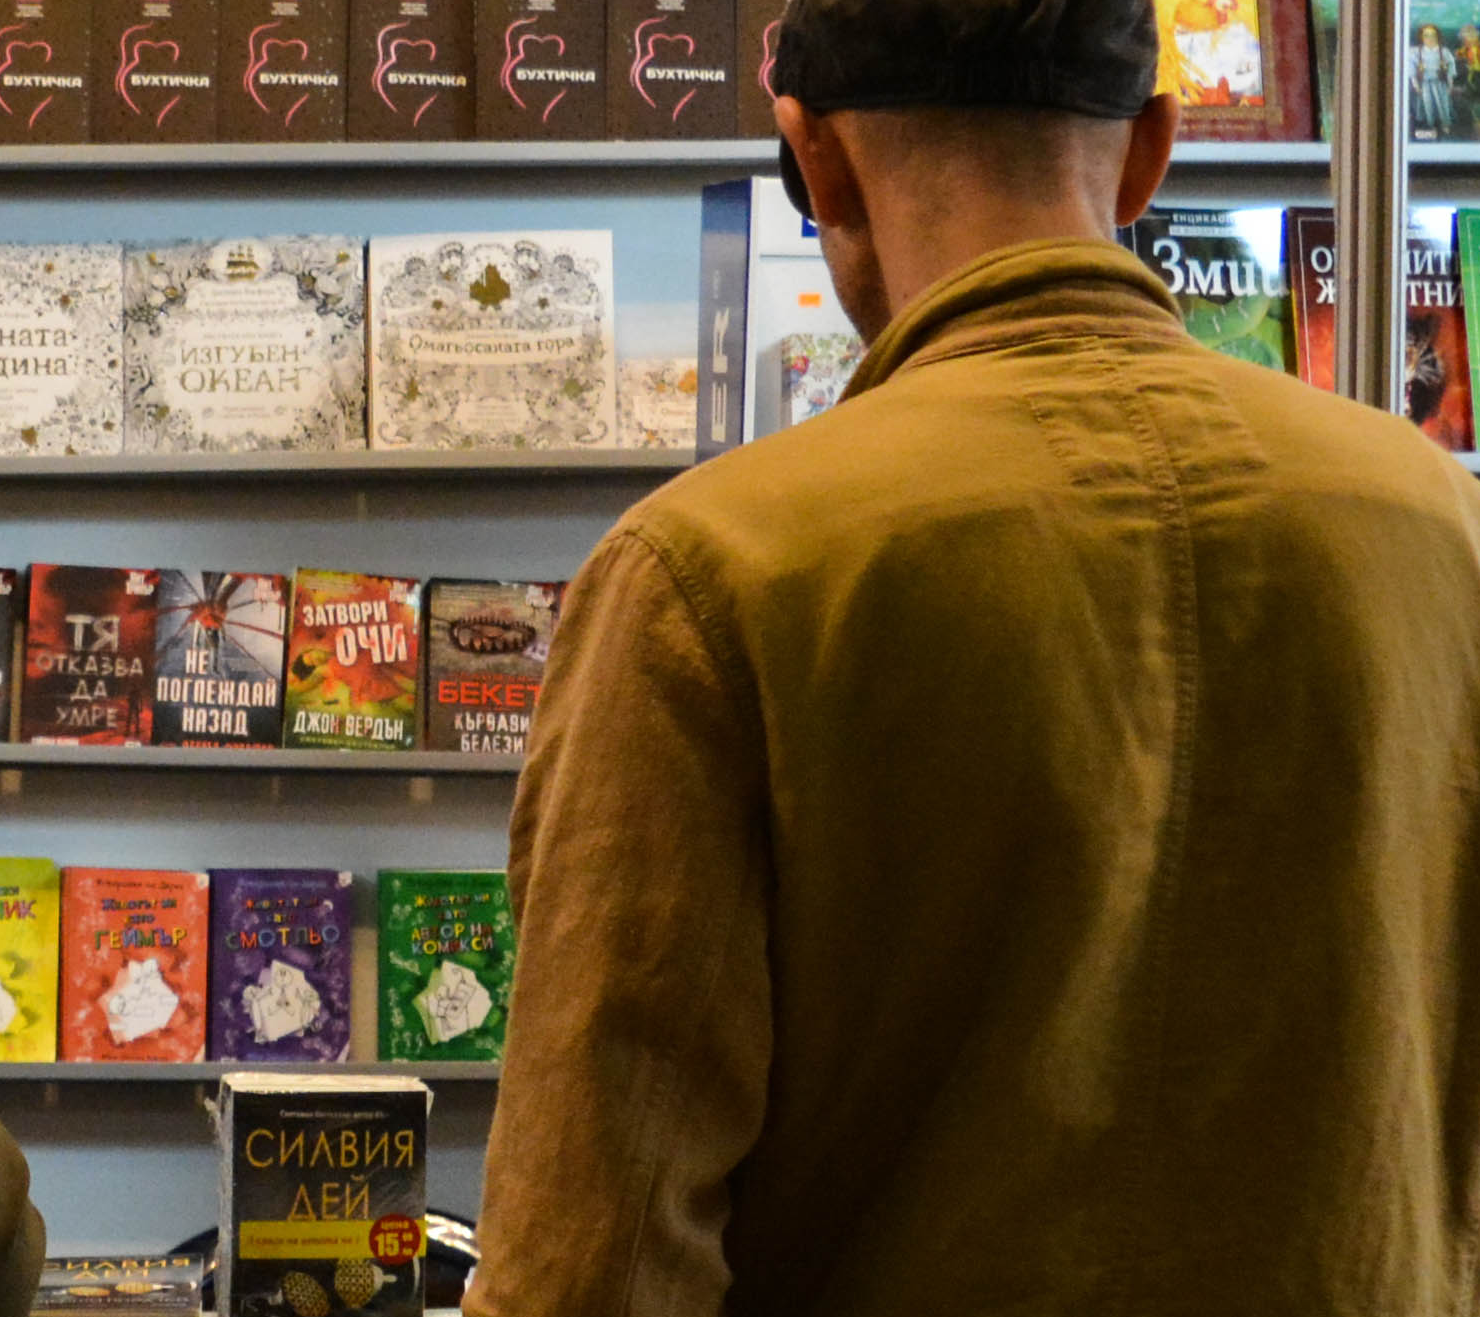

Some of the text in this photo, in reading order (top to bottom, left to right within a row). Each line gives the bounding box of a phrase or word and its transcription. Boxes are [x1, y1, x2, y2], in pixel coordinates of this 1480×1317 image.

[3, 75, 82, 90] БУХТИЧКА
[131, 74, 209, 89] БУХТИЧКА
[260, 72, 338, 87] БУХТИЧКА
[388, 72, 466, 87] БУХТИЧКА
[517, 68, 596, 82] БУХТИЧКА
[646, 68, 725, 82] БУХТИЧКА
[181, 345, 300, 365] ИЗГУБЕН
[409, 334, 576, 358] Омагьосаната гора
[179, 366, 312, 394] ОКЕАН
[302, 600, 388, 627] ЗАТВОРИ
[65, 614, 120, 652] ТЯ
[335, 624, 408, 667] ОЧИ
[37, 654, 143, 677] ОТКАЗВА
[185, 649, 209, 674] НЕ
[70, 679, 108, 702] ДА
[157, 678, 277, 707] ПОГЛЕЖДАЙ
[439, 680, 541, 704] БЕКЕТ
[56, 706, 118, 730] УМРЕ
[182, 709, 248, 736] НАЗАД
[293, 710, 404, 742] ДЖОН ВЕРДЪН
[454, 712, 530, 733] КЪРВАВИ
[460, 733, 526, 754] БЕЛЕЗИ
[95, 926, 187, 950] ГЕЙМЪР
[411, 936, 494, 956] КОМИКСИ
[246, 1128, 414, 1168] СИЛВИЯ
[288, 1174, 370, 1222] ДЕЙ
[375, 1233, 400, 1257] 15
